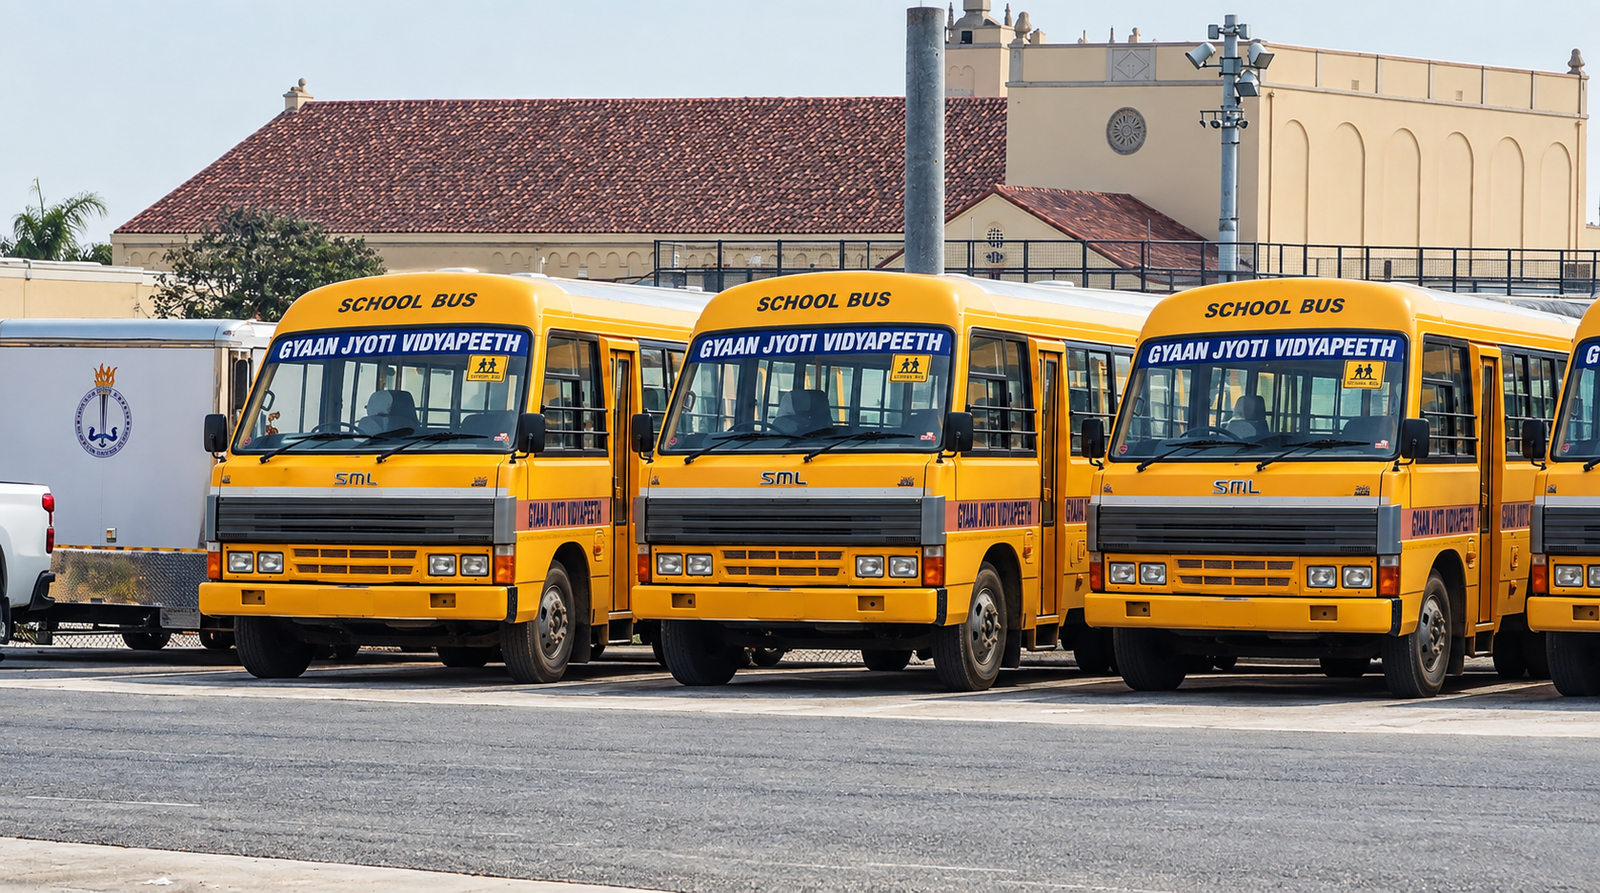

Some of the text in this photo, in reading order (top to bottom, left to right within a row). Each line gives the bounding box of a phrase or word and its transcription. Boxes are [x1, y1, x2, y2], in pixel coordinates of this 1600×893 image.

[338, 292, 478, 313] SCHOOL BUS
[757, 291, 892, 312] SCHOOL BUS
[1204, 298, 1345, 318] SCHOOL BUS
[279, 332, 522, 359] GYAAN JYOTI VIDYAPEETH
[699, 331, 943, 359] GYAAN JYOTI VIDYAPEETH
[1148, 337, 1397, 364] GYAAN JYOTI VIDYAPEETH
[1585, 345, 1600, 364] G
[334, 471, 378, 486] SML
[760, 470, 808, 486] SML
[1212, 479, 1261, 495] SML
[528, 502, 548, 528] GYAAN
[958, 503, 978, 529] GYAAN
